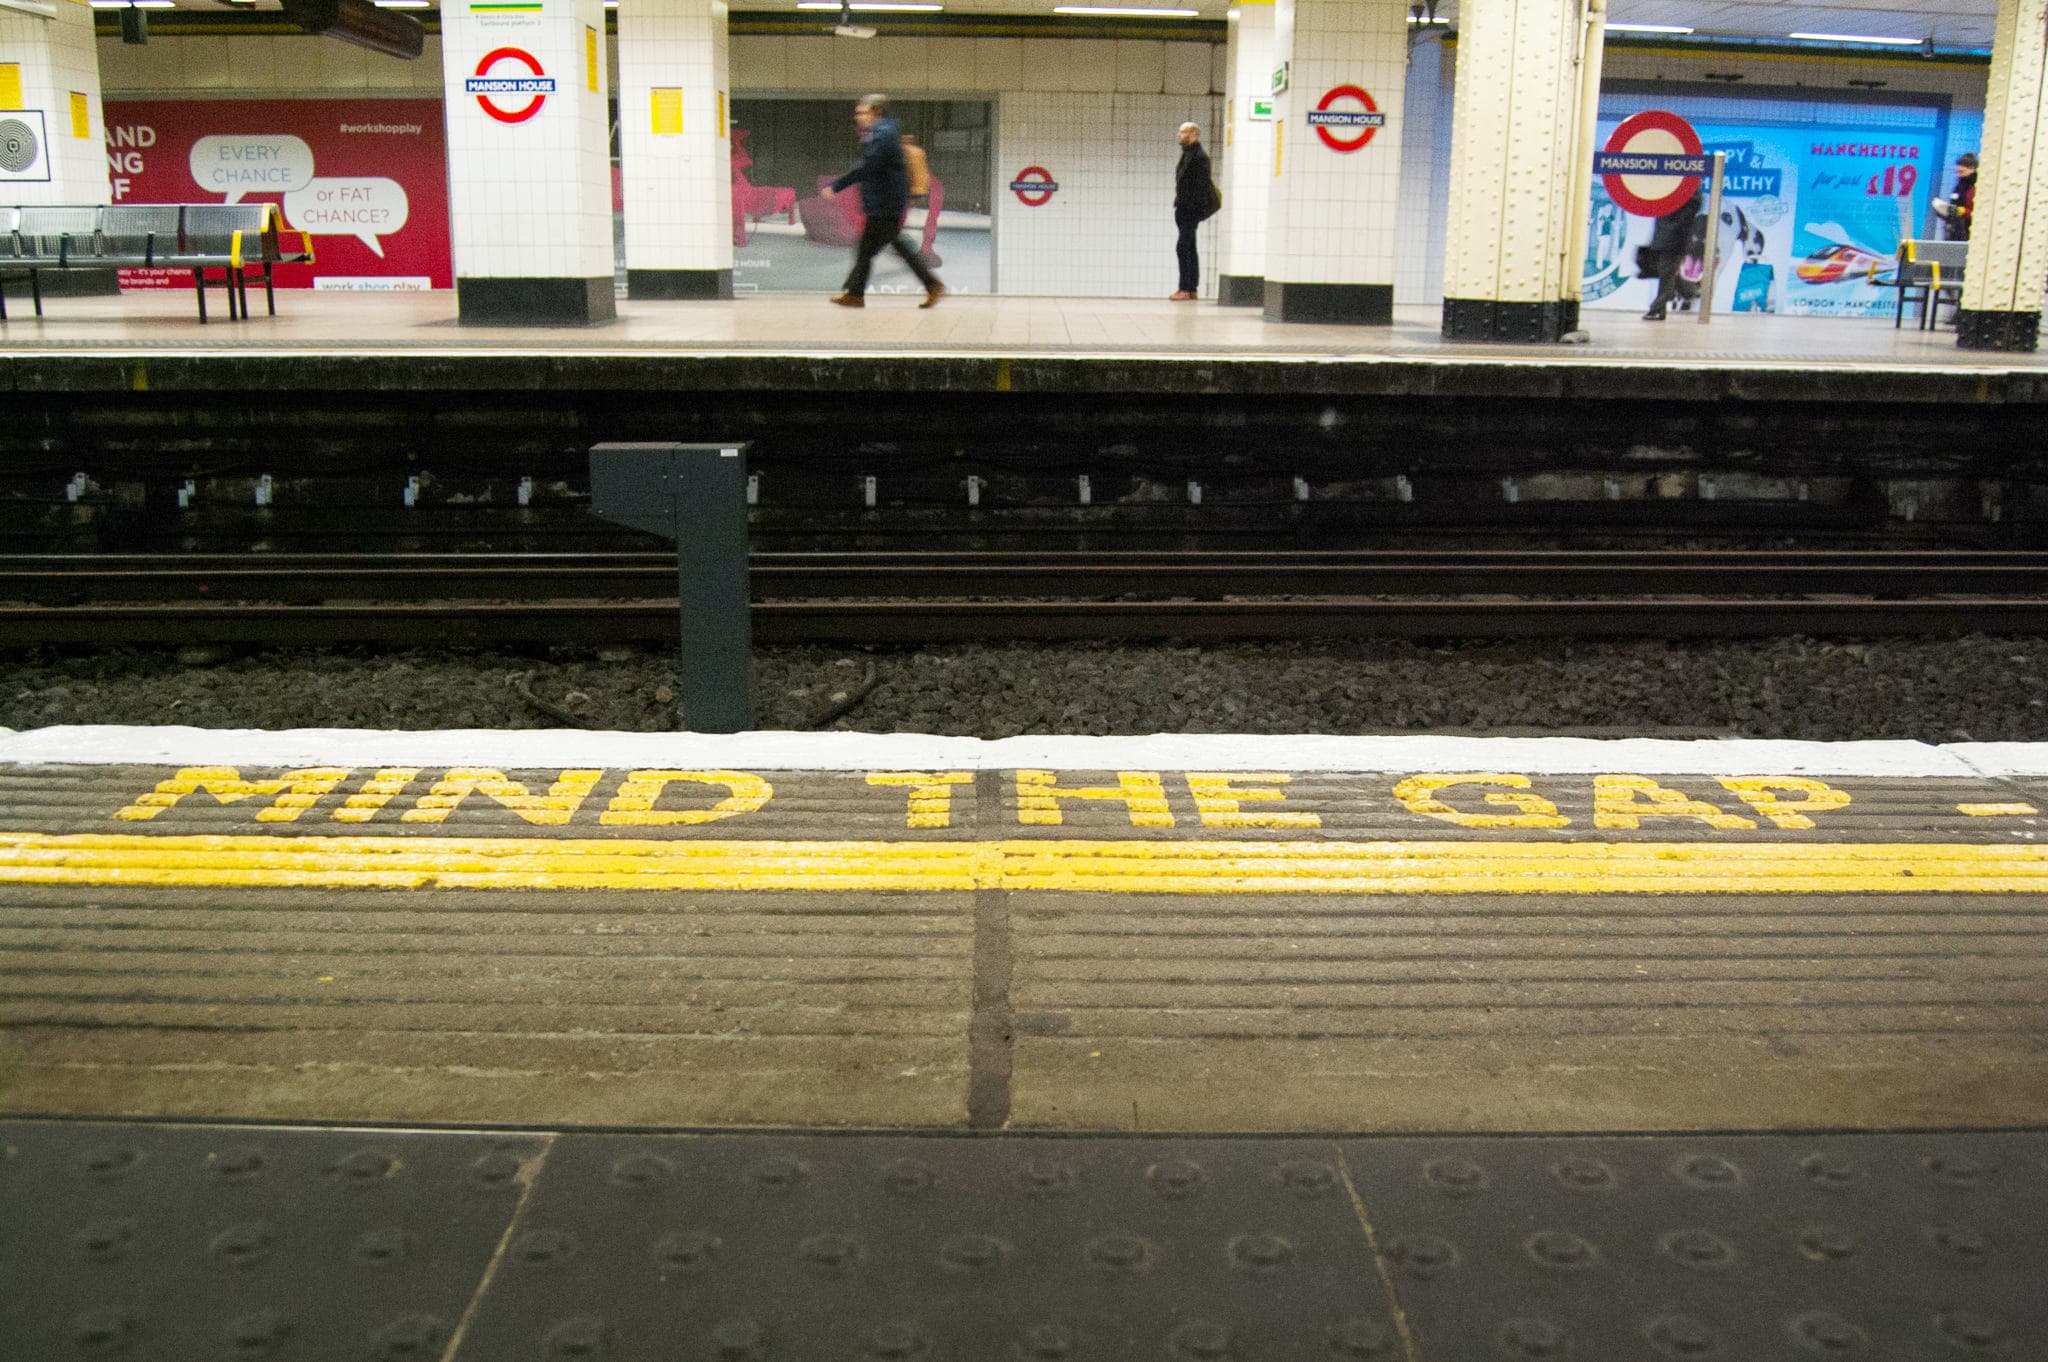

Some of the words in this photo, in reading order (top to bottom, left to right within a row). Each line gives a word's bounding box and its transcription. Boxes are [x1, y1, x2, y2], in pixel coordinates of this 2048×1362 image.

[468, 81, 516, 91] MANSION
[519, 81, 553, 91] HOUSE
[1310, 114, 1352, 123] MANSION
[1353, 115, 1382, 124] HOUSE
[340, 123, 422, 135] #workshopplay
[219, 145, 281, 161] EVERY
[1811, 142, 1920, 159] MANCHESTER
[1600, 157, 1658, 170] MANSION
[1663, 159, 1705, 171] HOUSE
[212, 167, 292, 184] CHANCE
[316, 190, 334, 202] or
[340, 187, 372, 202] FAT
[303, 208, 390, 224] CHANCE?
[1794, 298, 1835, 308] LONDON
[112, 765, 773, 826] MIND
[865, 769, 1322, 829] THE
[1392, 772, 1852, 830] GAP
